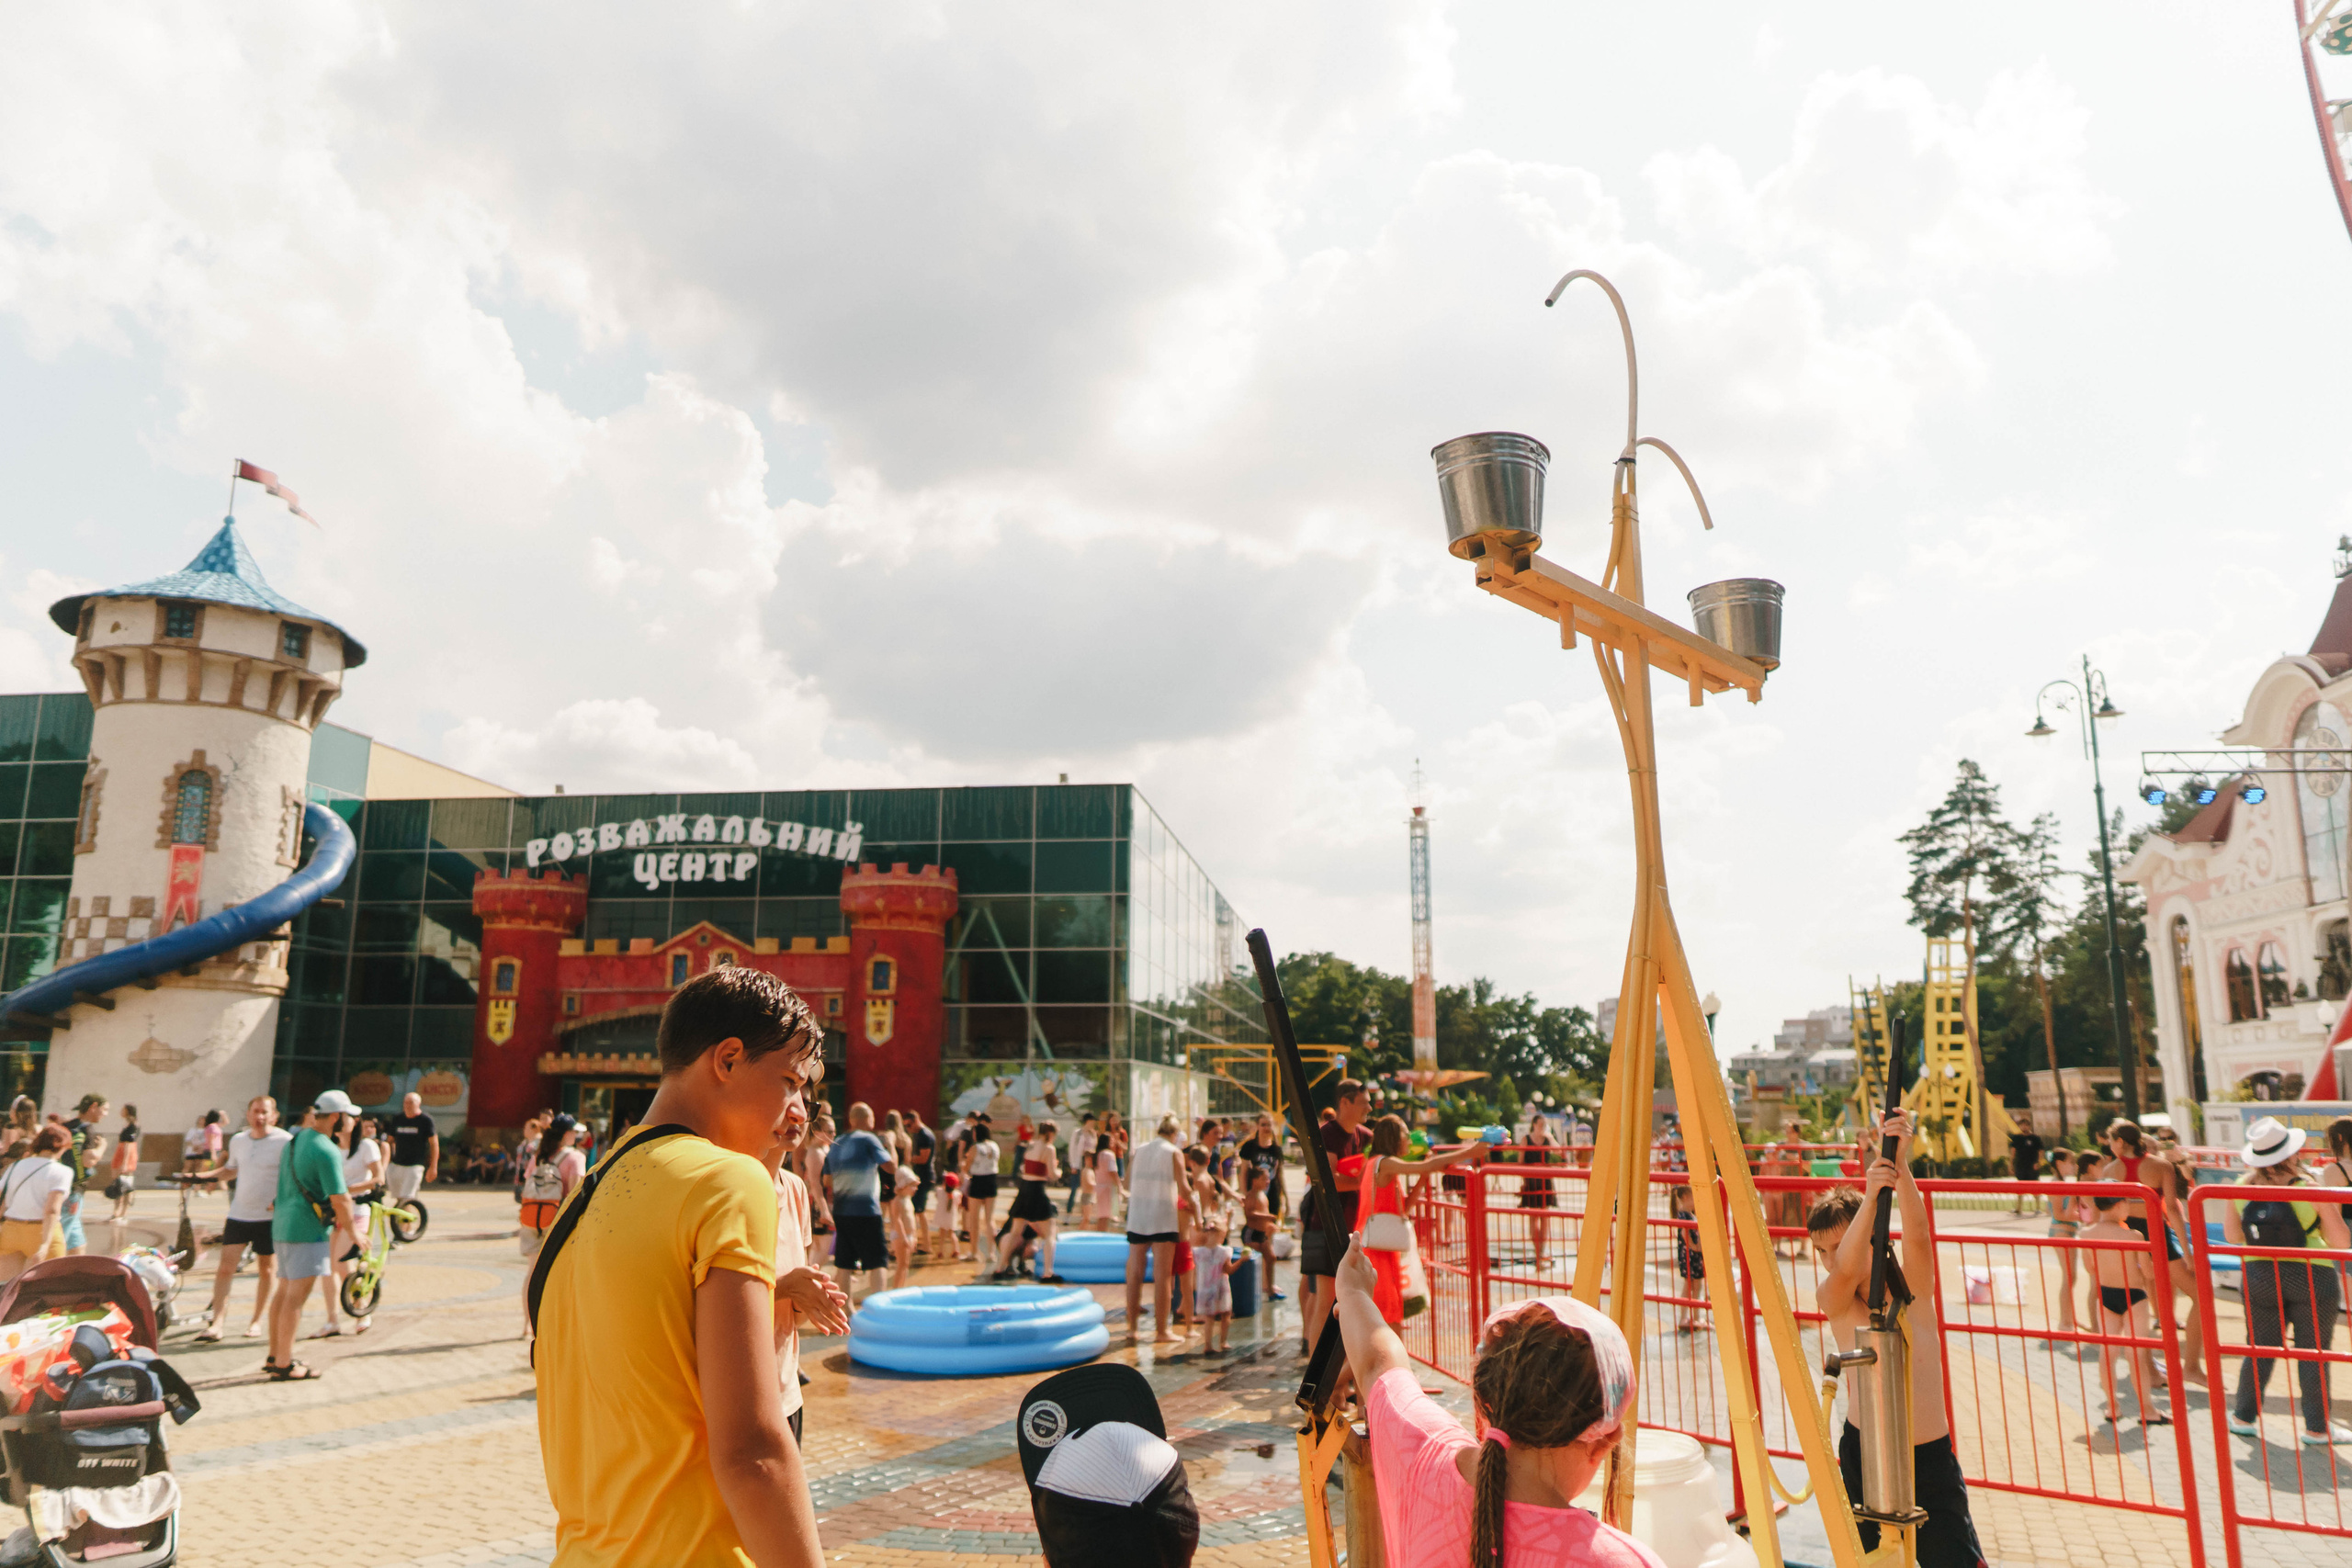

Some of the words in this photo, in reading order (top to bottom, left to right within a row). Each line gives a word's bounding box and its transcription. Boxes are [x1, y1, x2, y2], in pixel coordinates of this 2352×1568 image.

[526, 813, 864, 867] РОЗВАЖАЛЬНИЙ
[634, 852, 758, 890] ЦЕНТР
[77, 1458, 99, 1468] OFF
[101, 1458, 139, 1468] WHITE
